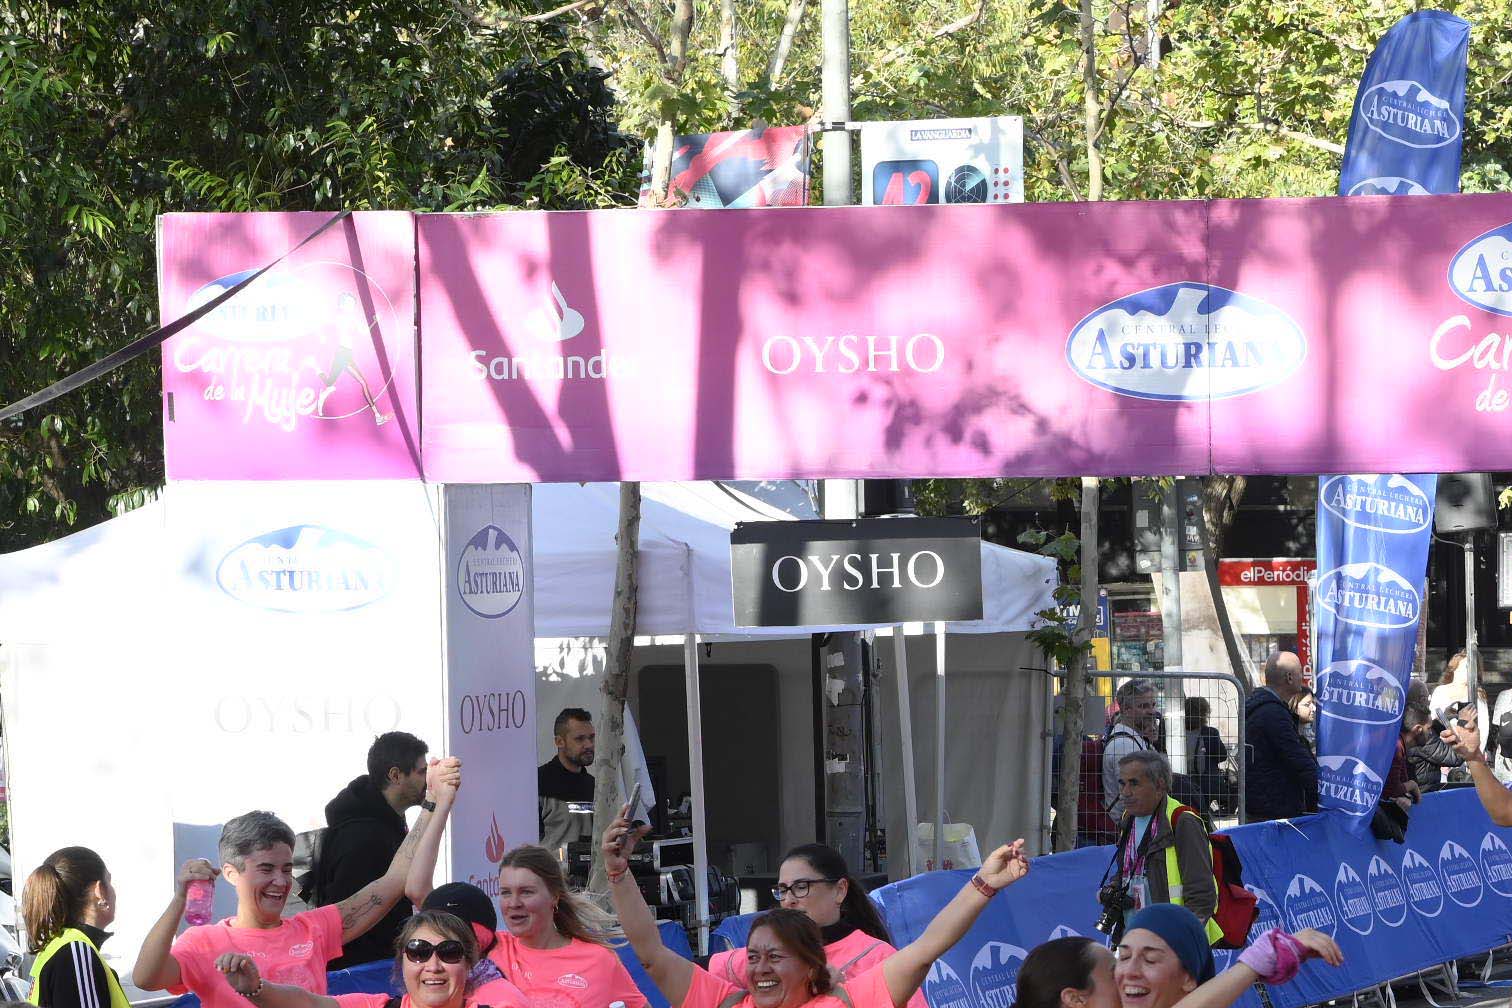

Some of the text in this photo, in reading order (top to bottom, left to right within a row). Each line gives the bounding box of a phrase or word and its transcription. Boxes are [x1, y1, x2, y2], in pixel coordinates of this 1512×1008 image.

[1367, 94, 1450, 139] ASTURIANA
[761, 333, 945, 374] OYSHO
[203, 377, 225, 401] de
[1475, 377, 1511, 413] de
[1330, 483, 1425, 525] ASTURIANA
[233, 559, 370, 592] ASTURIAN
[463, 559, 520, 596] ASTURIANA
[772, 549, 945, 593] OYSHO
[1325, 579, 1414, 619] ASTURIANA
[214, 698, 402, 734] OYSHO
[460, 690, 527, 734] OYSHO
[1320, 686, 1400, 715] STURIANA
